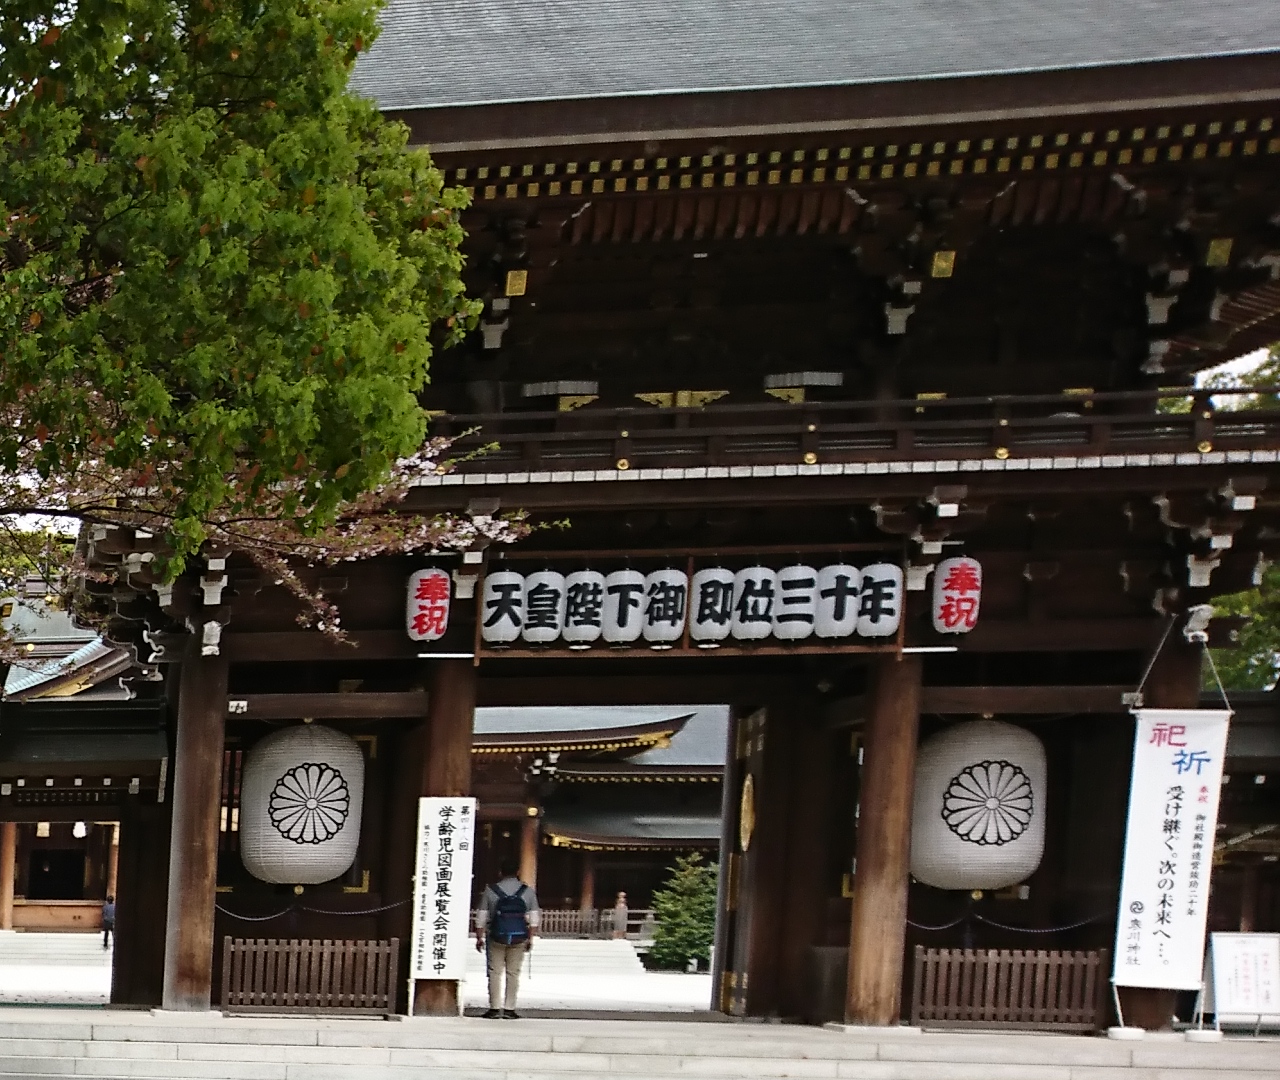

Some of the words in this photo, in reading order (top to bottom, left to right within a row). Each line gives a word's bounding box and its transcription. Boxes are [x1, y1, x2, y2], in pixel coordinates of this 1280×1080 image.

[411, 573, 448, 635] 奉祝
[939, 563, 980, 628] 奉祝
[1149, 723, 1188, 748] 祀
[1171, 750, 1212, 776] 祈
[432, 805, 457, 975] 学齢児図画展覧会開催中
